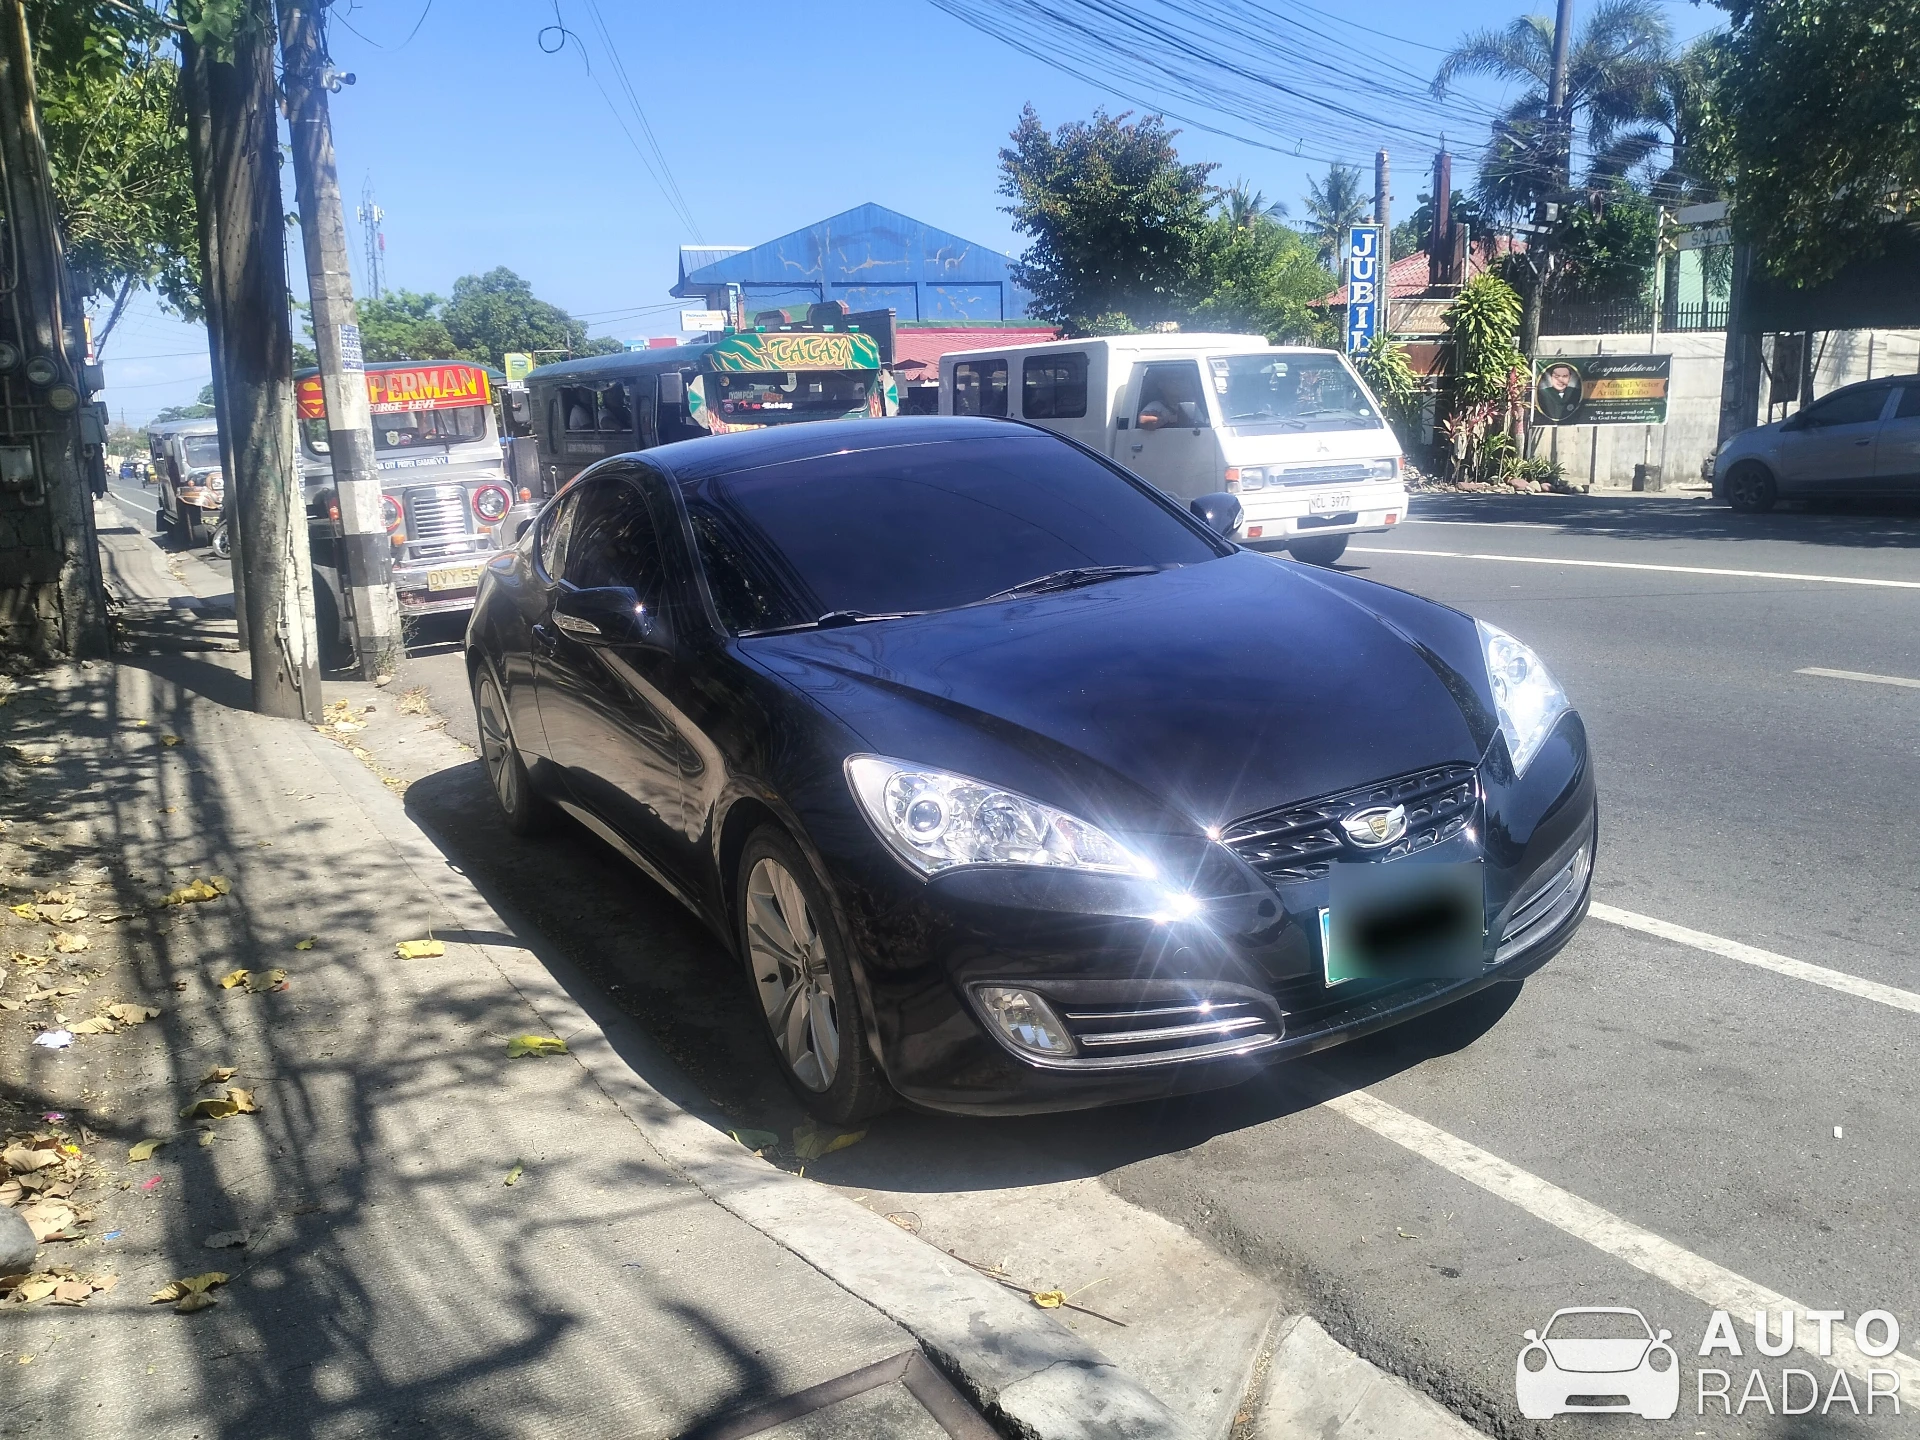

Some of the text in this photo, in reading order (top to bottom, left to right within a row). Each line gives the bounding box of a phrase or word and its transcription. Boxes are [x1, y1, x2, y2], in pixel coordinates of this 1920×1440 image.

[1351, 233, 1375, 365] JUBIL
[1584, 361, 1666, 376] Congratulations!
[369, 399, 435, 412] EORGE LEVI
[1331, 496, 1350, 507] 3977
[462, 568, 479, 582] 55
